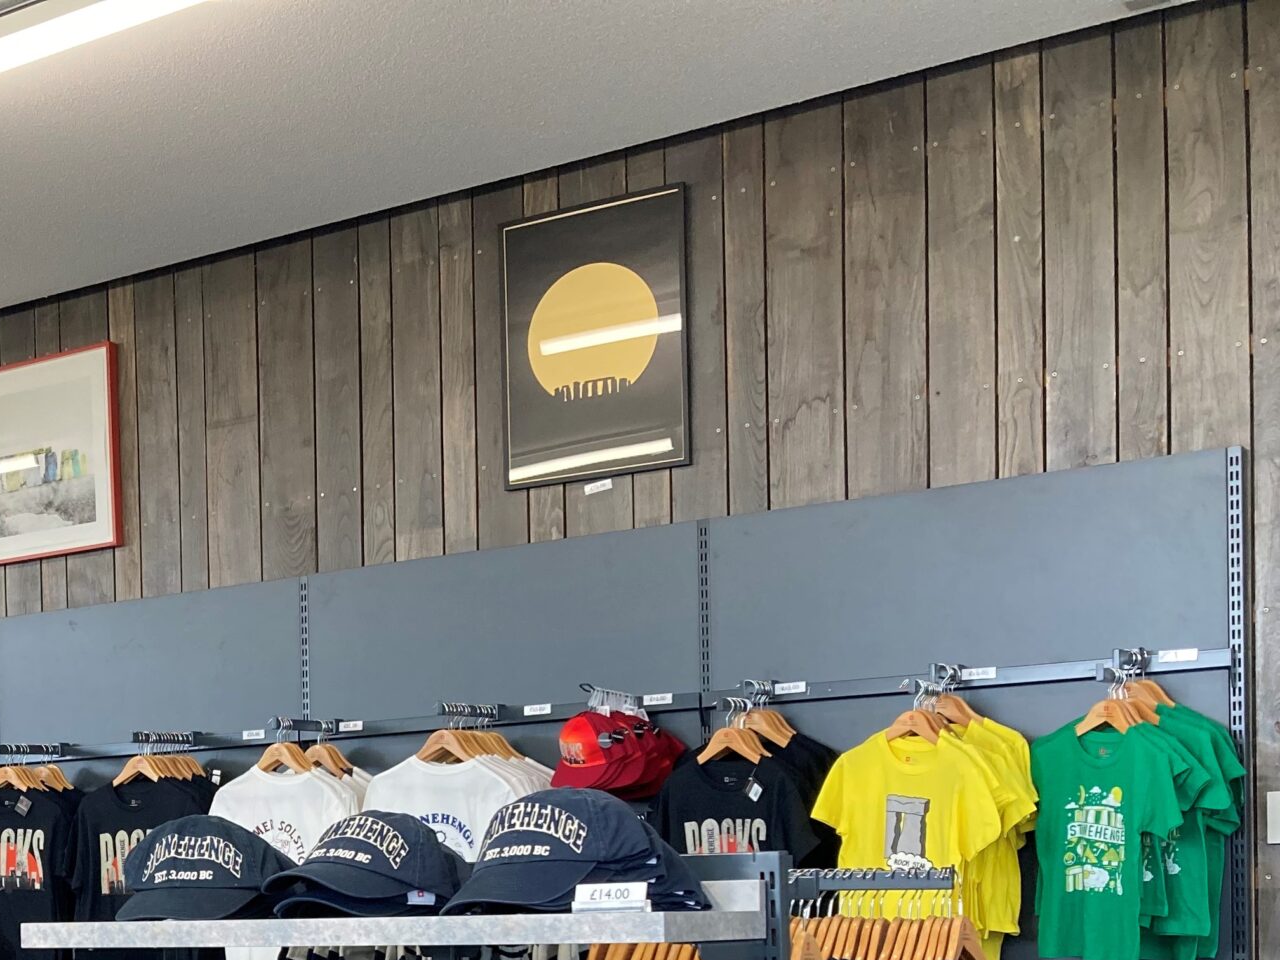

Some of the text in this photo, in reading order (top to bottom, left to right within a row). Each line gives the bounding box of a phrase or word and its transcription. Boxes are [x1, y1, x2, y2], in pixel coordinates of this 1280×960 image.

[533, 845, 551, 857] BC
[355, 853, 372, 863] BC
[199, 870, 214, 880] BC
[590, 888, 630, 901] £14.00
